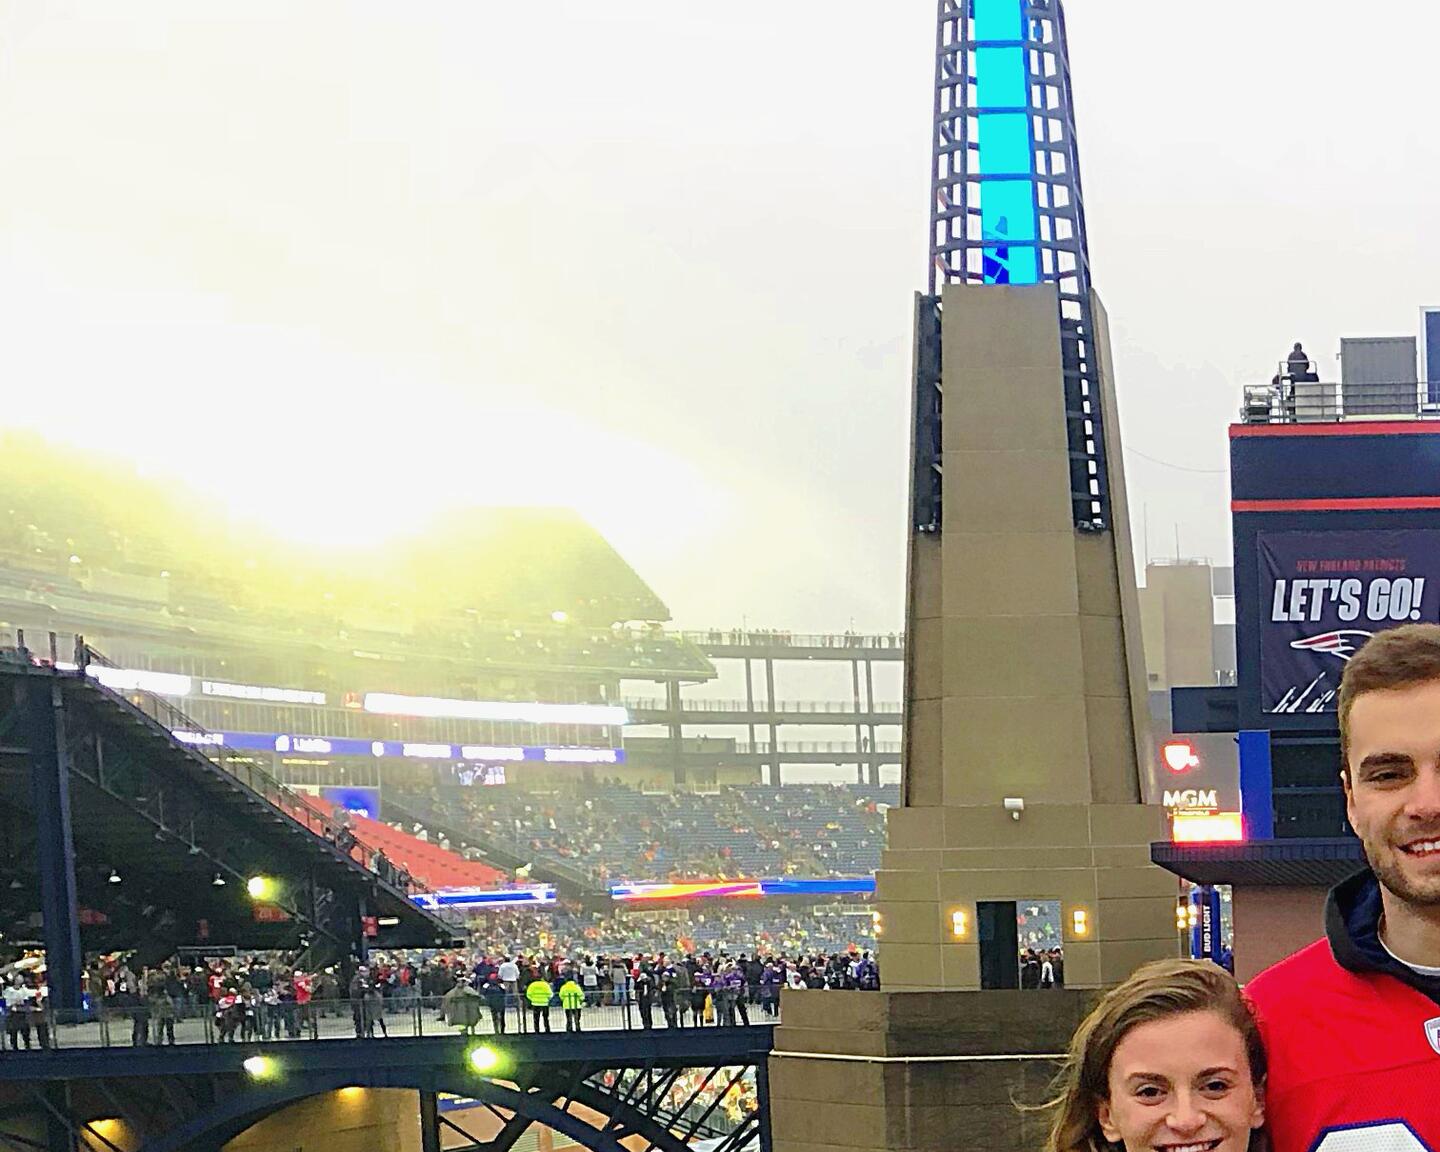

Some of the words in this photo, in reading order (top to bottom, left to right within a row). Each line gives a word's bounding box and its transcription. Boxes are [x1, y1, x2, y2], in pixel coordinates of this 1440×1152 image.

[1271, 579, 1362, 621] LET'S
[1366, 578, 1425, 621] GO!
[1162, 789, 1218, 807] MGM
